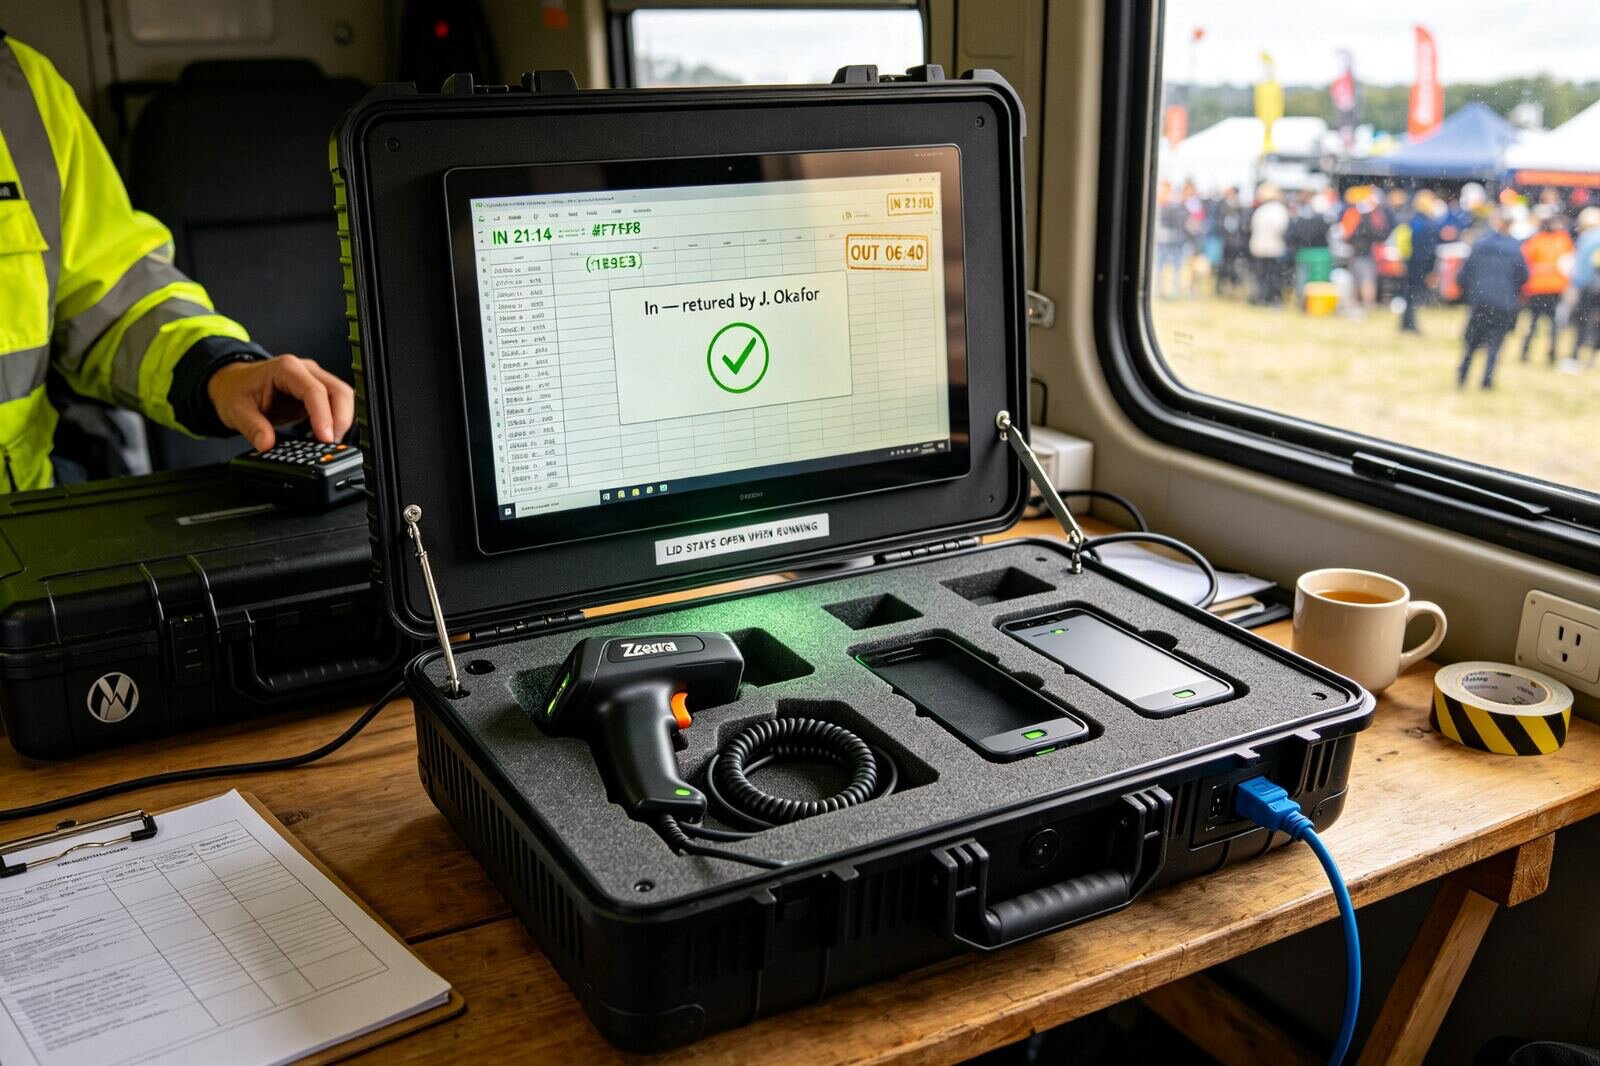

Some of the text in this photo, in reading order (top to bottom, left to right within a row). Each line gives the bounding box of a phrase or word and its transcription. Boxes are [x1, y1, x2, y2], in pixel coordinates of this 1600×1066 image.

[492, 230, 508, 245] IN
[851, 244, 880, 261] OUT
[644, 301, 658, 315] In
[682, 293, 735, 312] retured
[739, 292, 756, 310] by
[759, 291, 770, 306] J.
[773, 287, 820, 305] Okafor
[686, 539, 717, 553] STAYS
